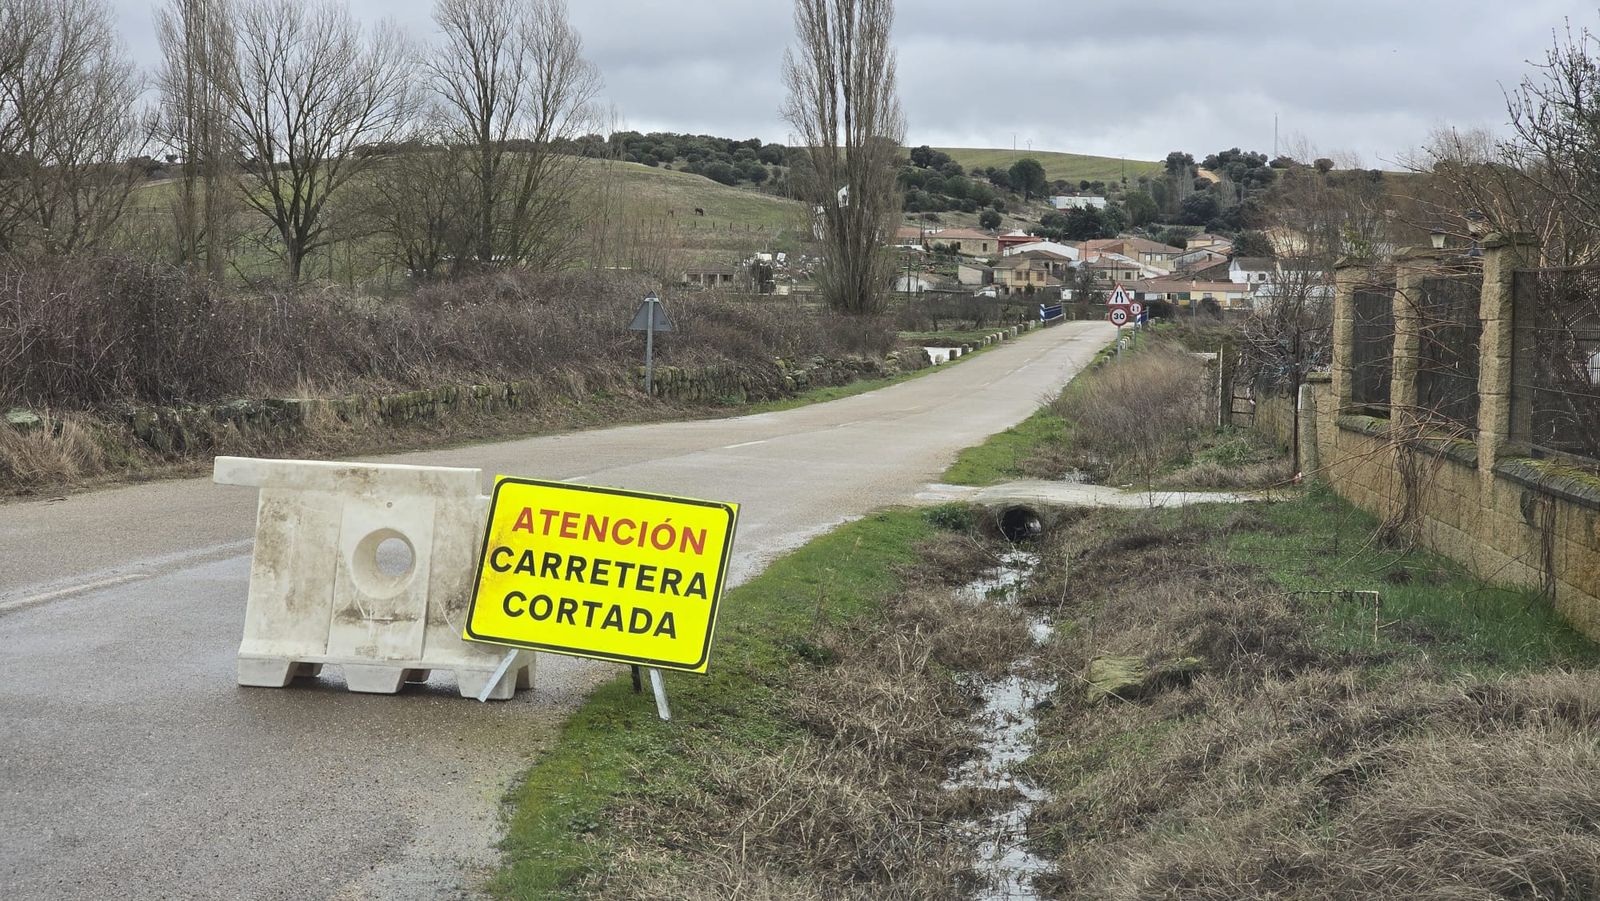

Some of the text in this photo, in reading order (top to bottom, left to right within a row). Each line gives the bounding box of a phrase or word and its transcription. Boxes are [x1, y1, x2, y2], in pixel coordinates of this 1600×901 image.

[512, 507, 707, 555] ATENCIÓN
[490, 546, 708, 599] CARRETERA
[503, 591, 677, 639] CORTADA
